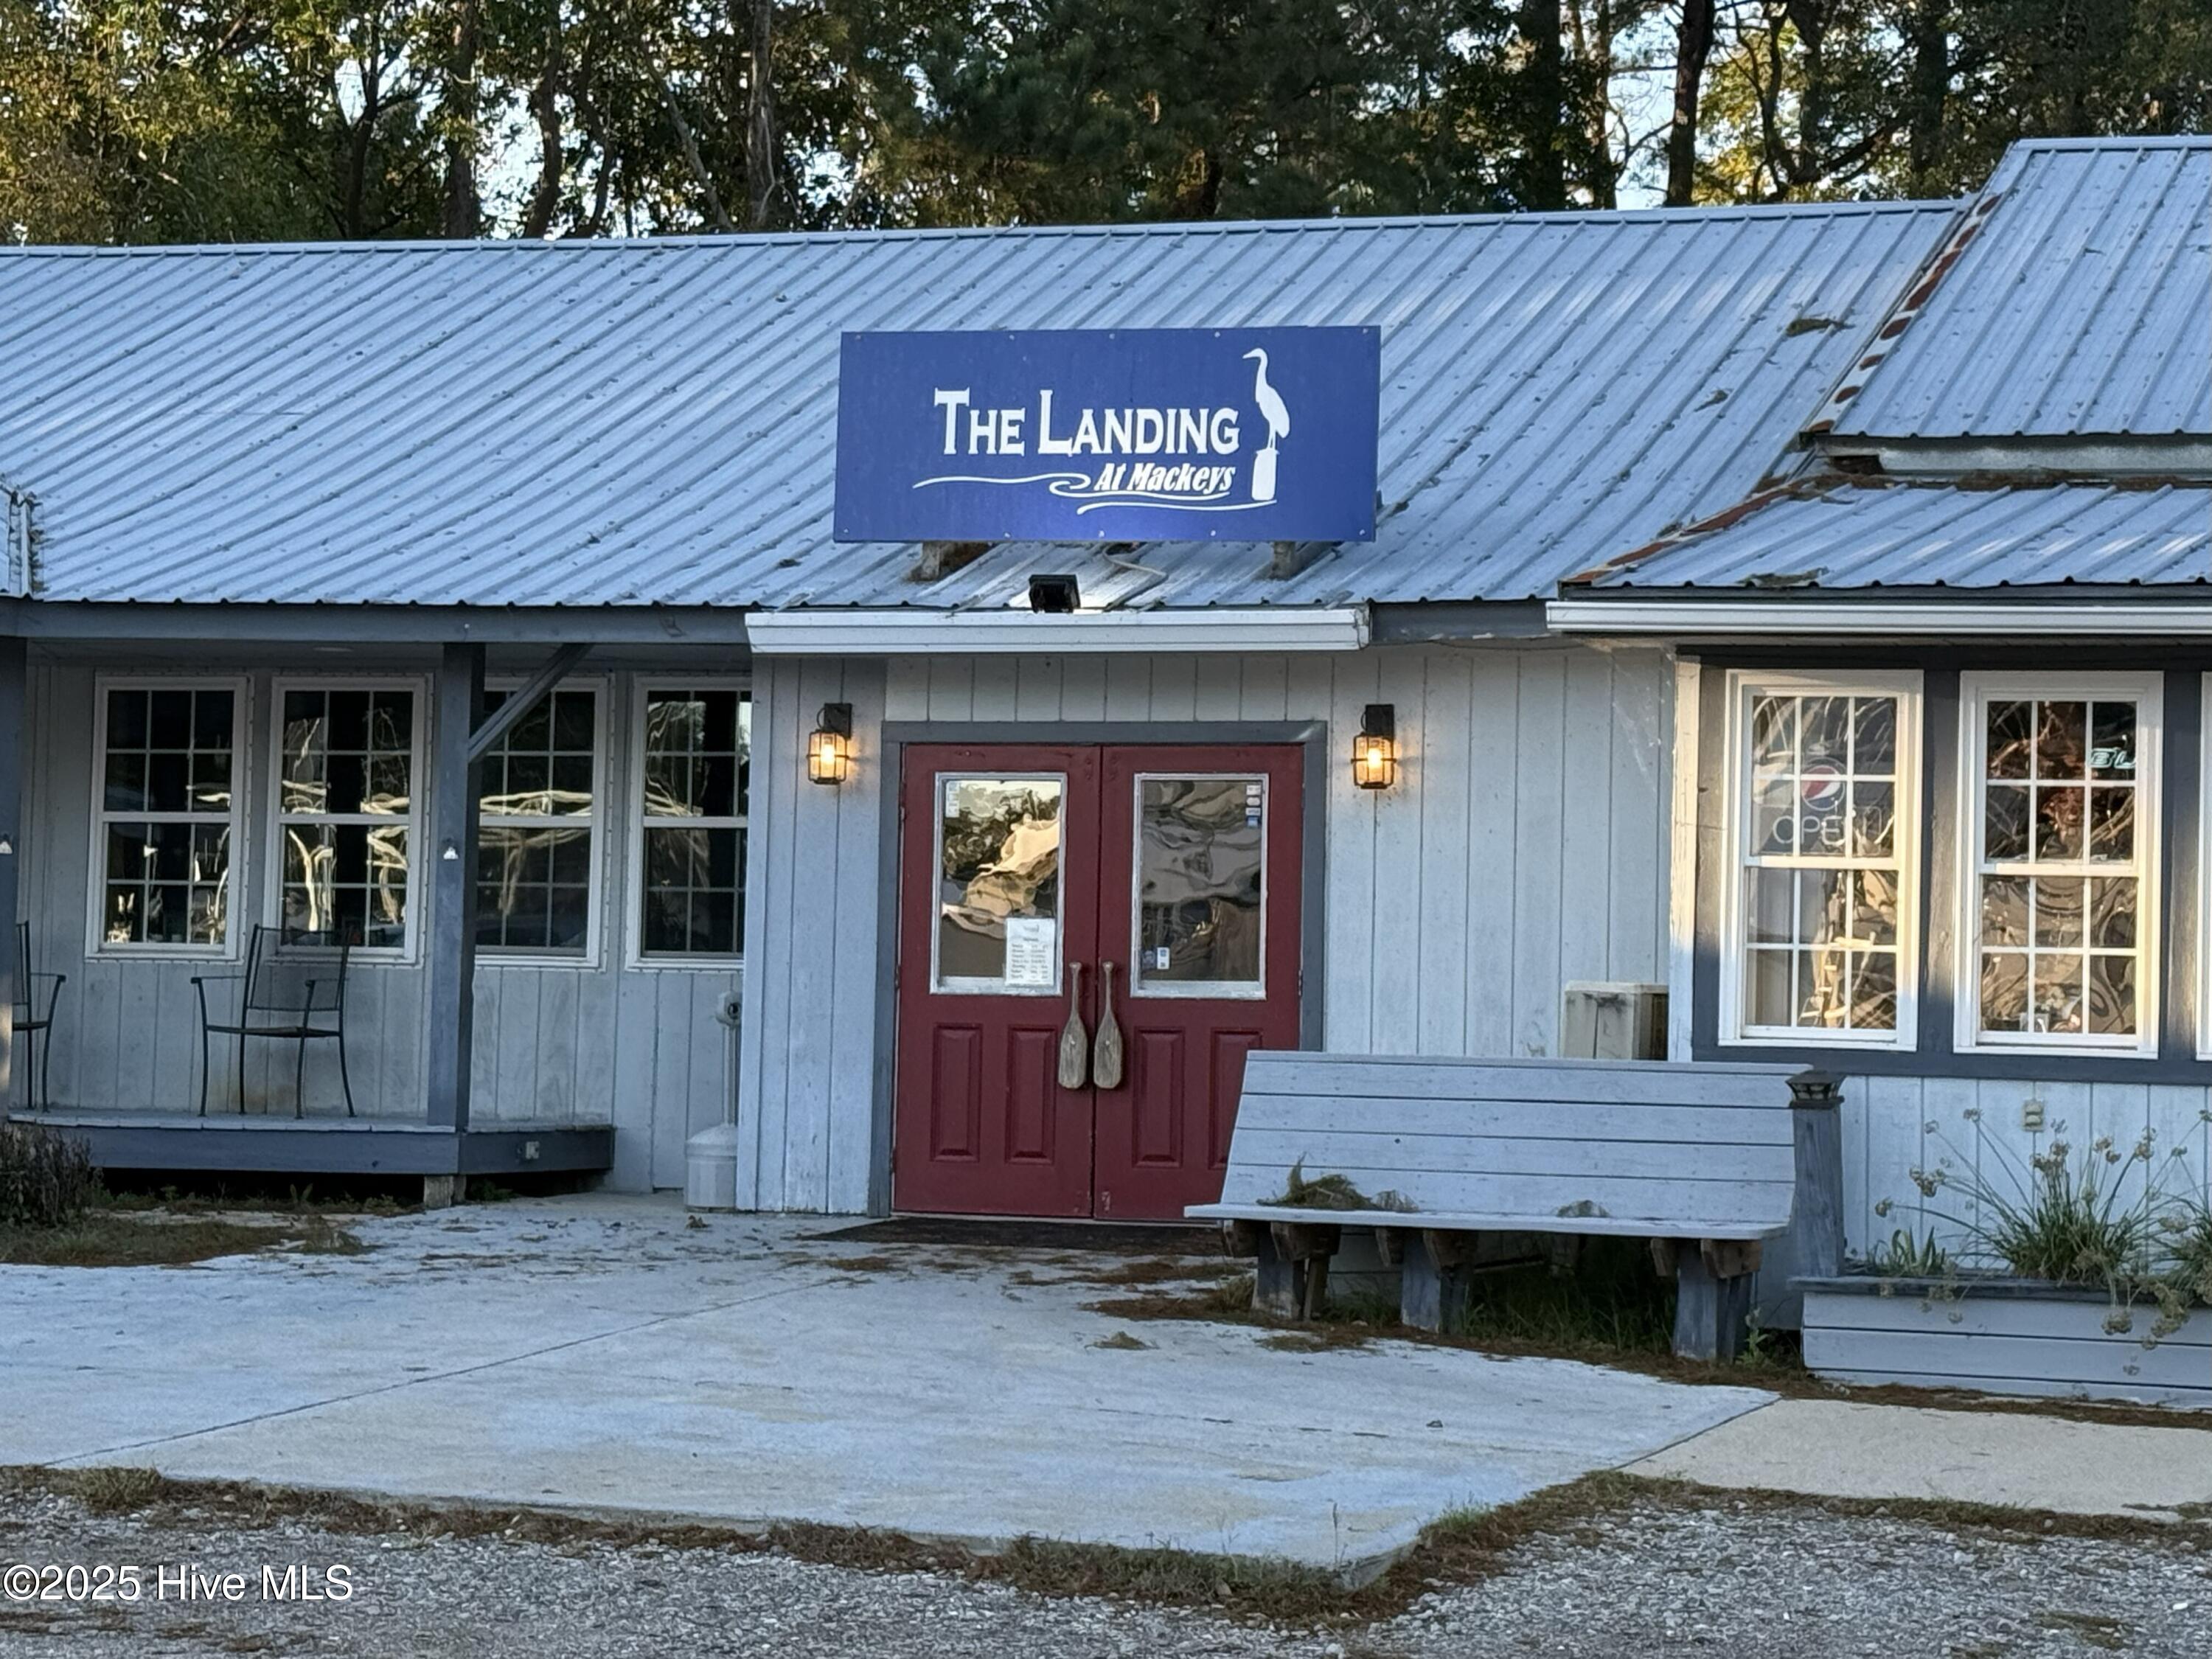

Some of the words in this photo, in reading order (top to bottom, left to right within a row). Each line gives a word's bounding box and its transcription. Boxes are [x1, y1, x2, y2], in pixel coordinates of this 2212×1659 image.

[934, 387, 1026, 456] THE
[1037, 389, 1240, 457] LANDING
[1093, 463, 1127, 491] At
[1127, 462, 1237, 495] Mackeys
